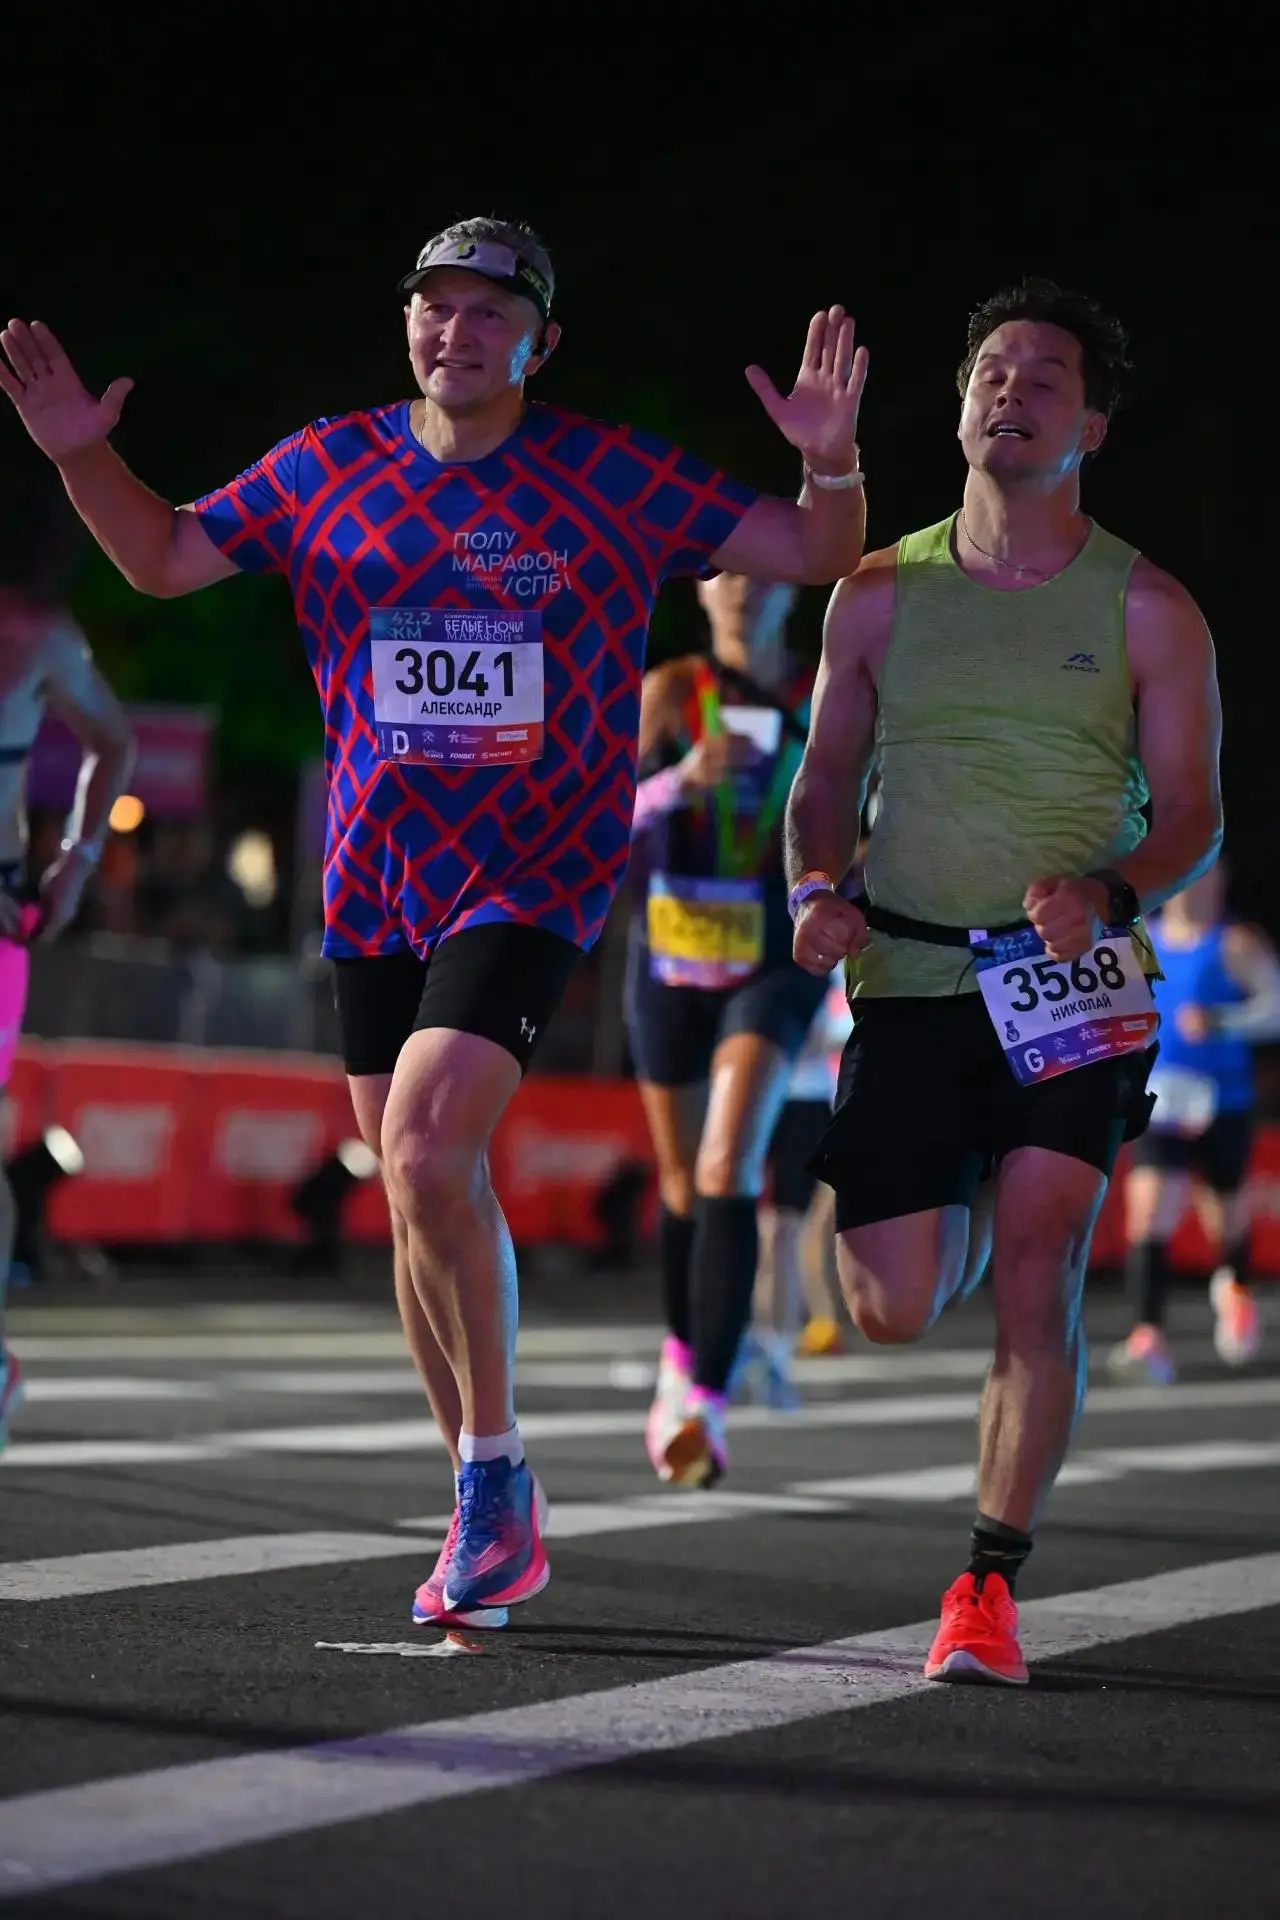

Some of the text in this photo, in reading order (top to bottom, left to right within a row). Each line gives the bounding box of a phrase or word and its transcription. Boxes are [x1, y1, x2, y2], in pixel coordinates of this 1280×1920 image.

[453, 530, 516, 550] ПОЛУ
[452, 549, 568, 572] МАРАФОН
[392, 611, 432, 626] 42,2
[445, 620, 524, 633] БЕЛЫЕ НОЧИ
[393, 626, 422, 640] КМ
[446, 631, 512, 642] МАРАФОН
[395, 648, 514, 697] 3041
[420, 701, 502, 718] АЛЕКСАНДР
[392, 730, 410, 754] D
[1003, 946, 1126, 1012] 3568
[1050, 993, 1112, 1022] НИКОЛАЙ
[1023, 1047, 1045, 1073] G
